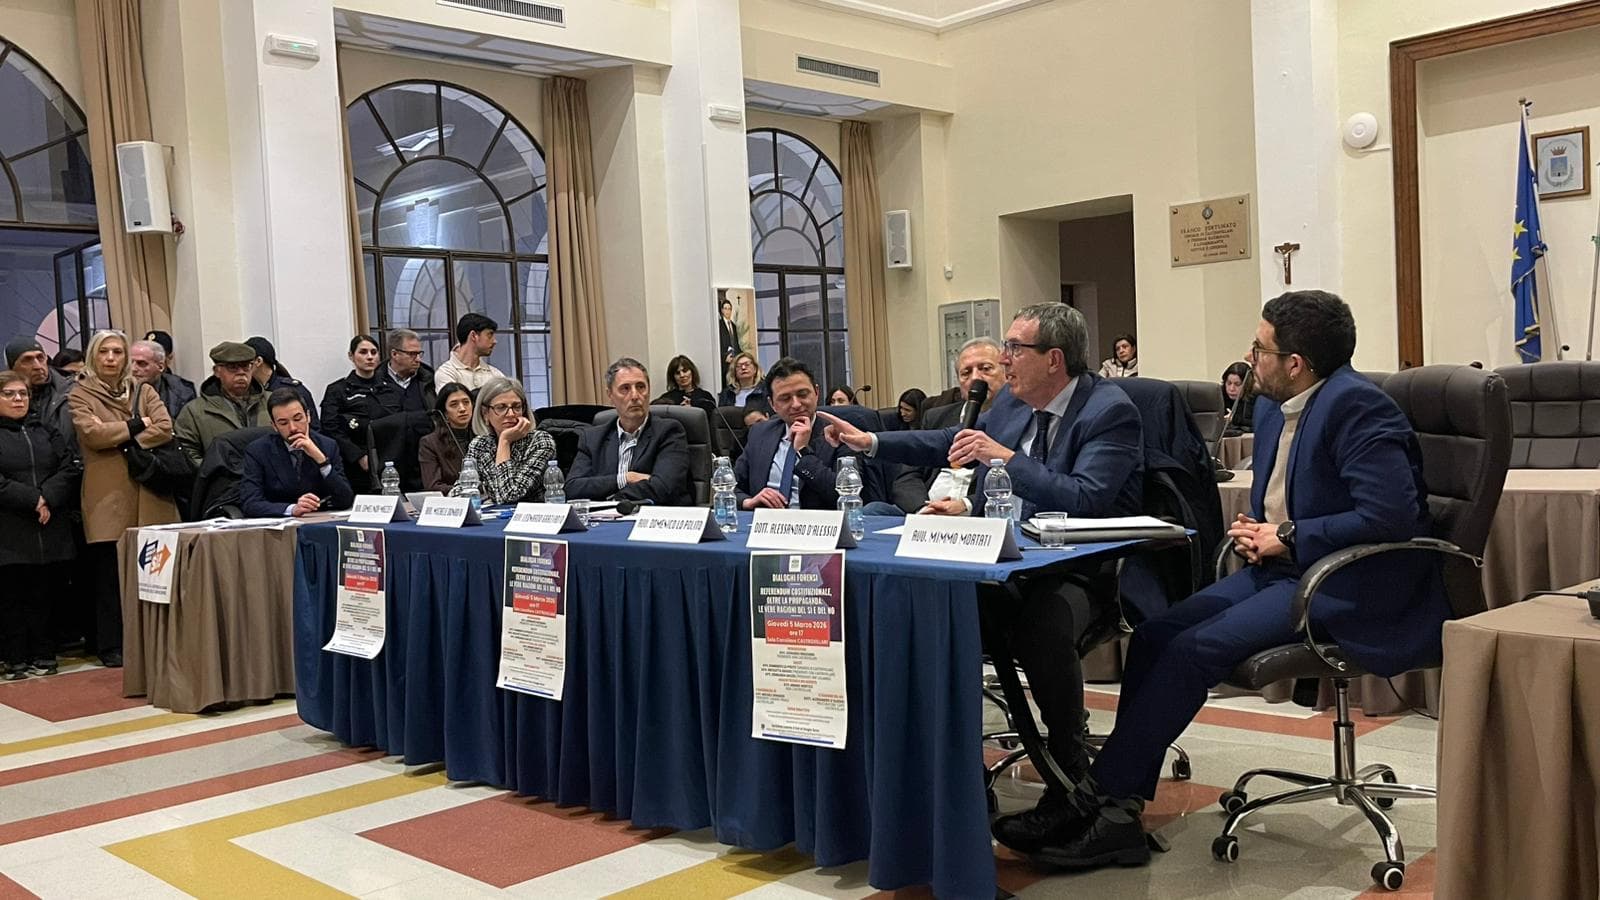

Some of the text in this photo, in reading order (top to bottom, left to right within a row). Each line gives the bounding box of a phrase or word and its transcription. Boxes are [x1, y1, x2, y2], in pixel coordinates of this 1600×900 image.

[649, 519, 676, 529] DOMENICO
[684, 520, 703, 530] POLITO
[754, 522, 837, 537] DOTT. ALESSANDRO D'ALESSIO
[930, 530, 958, 544] MIMMO
[960, 533, 992, 546] MORTATI
[772, 574, 818, 582] DIALOGHI FORENSI
[777, 606, 796, 614] RAGIONI
[798, 606, 806, 614] DEL
